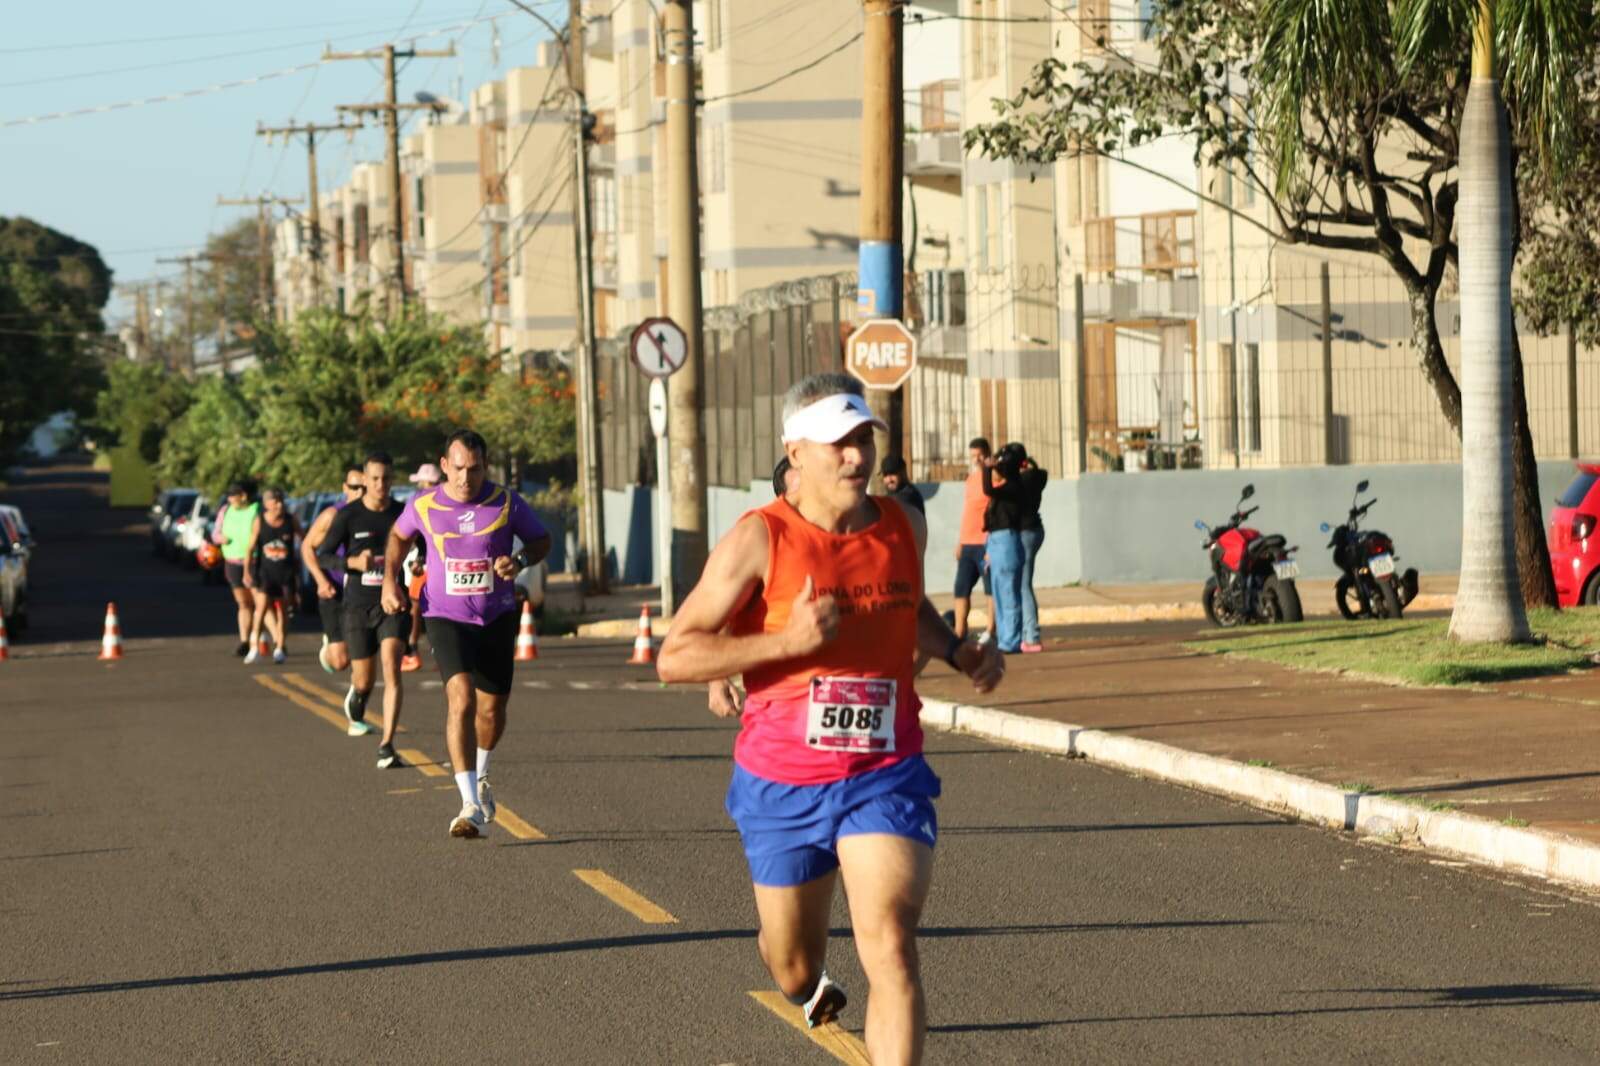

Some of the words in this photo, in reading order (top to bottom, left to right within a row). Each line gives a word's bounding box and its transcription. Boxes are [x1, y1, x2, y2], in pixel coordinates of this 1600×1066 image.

[855, 342, 907, 367] PARE
[453, 572, 484, 585] 5577
[854, 583, 873, 598] DO
[822, 706, 883, 731] 5085
